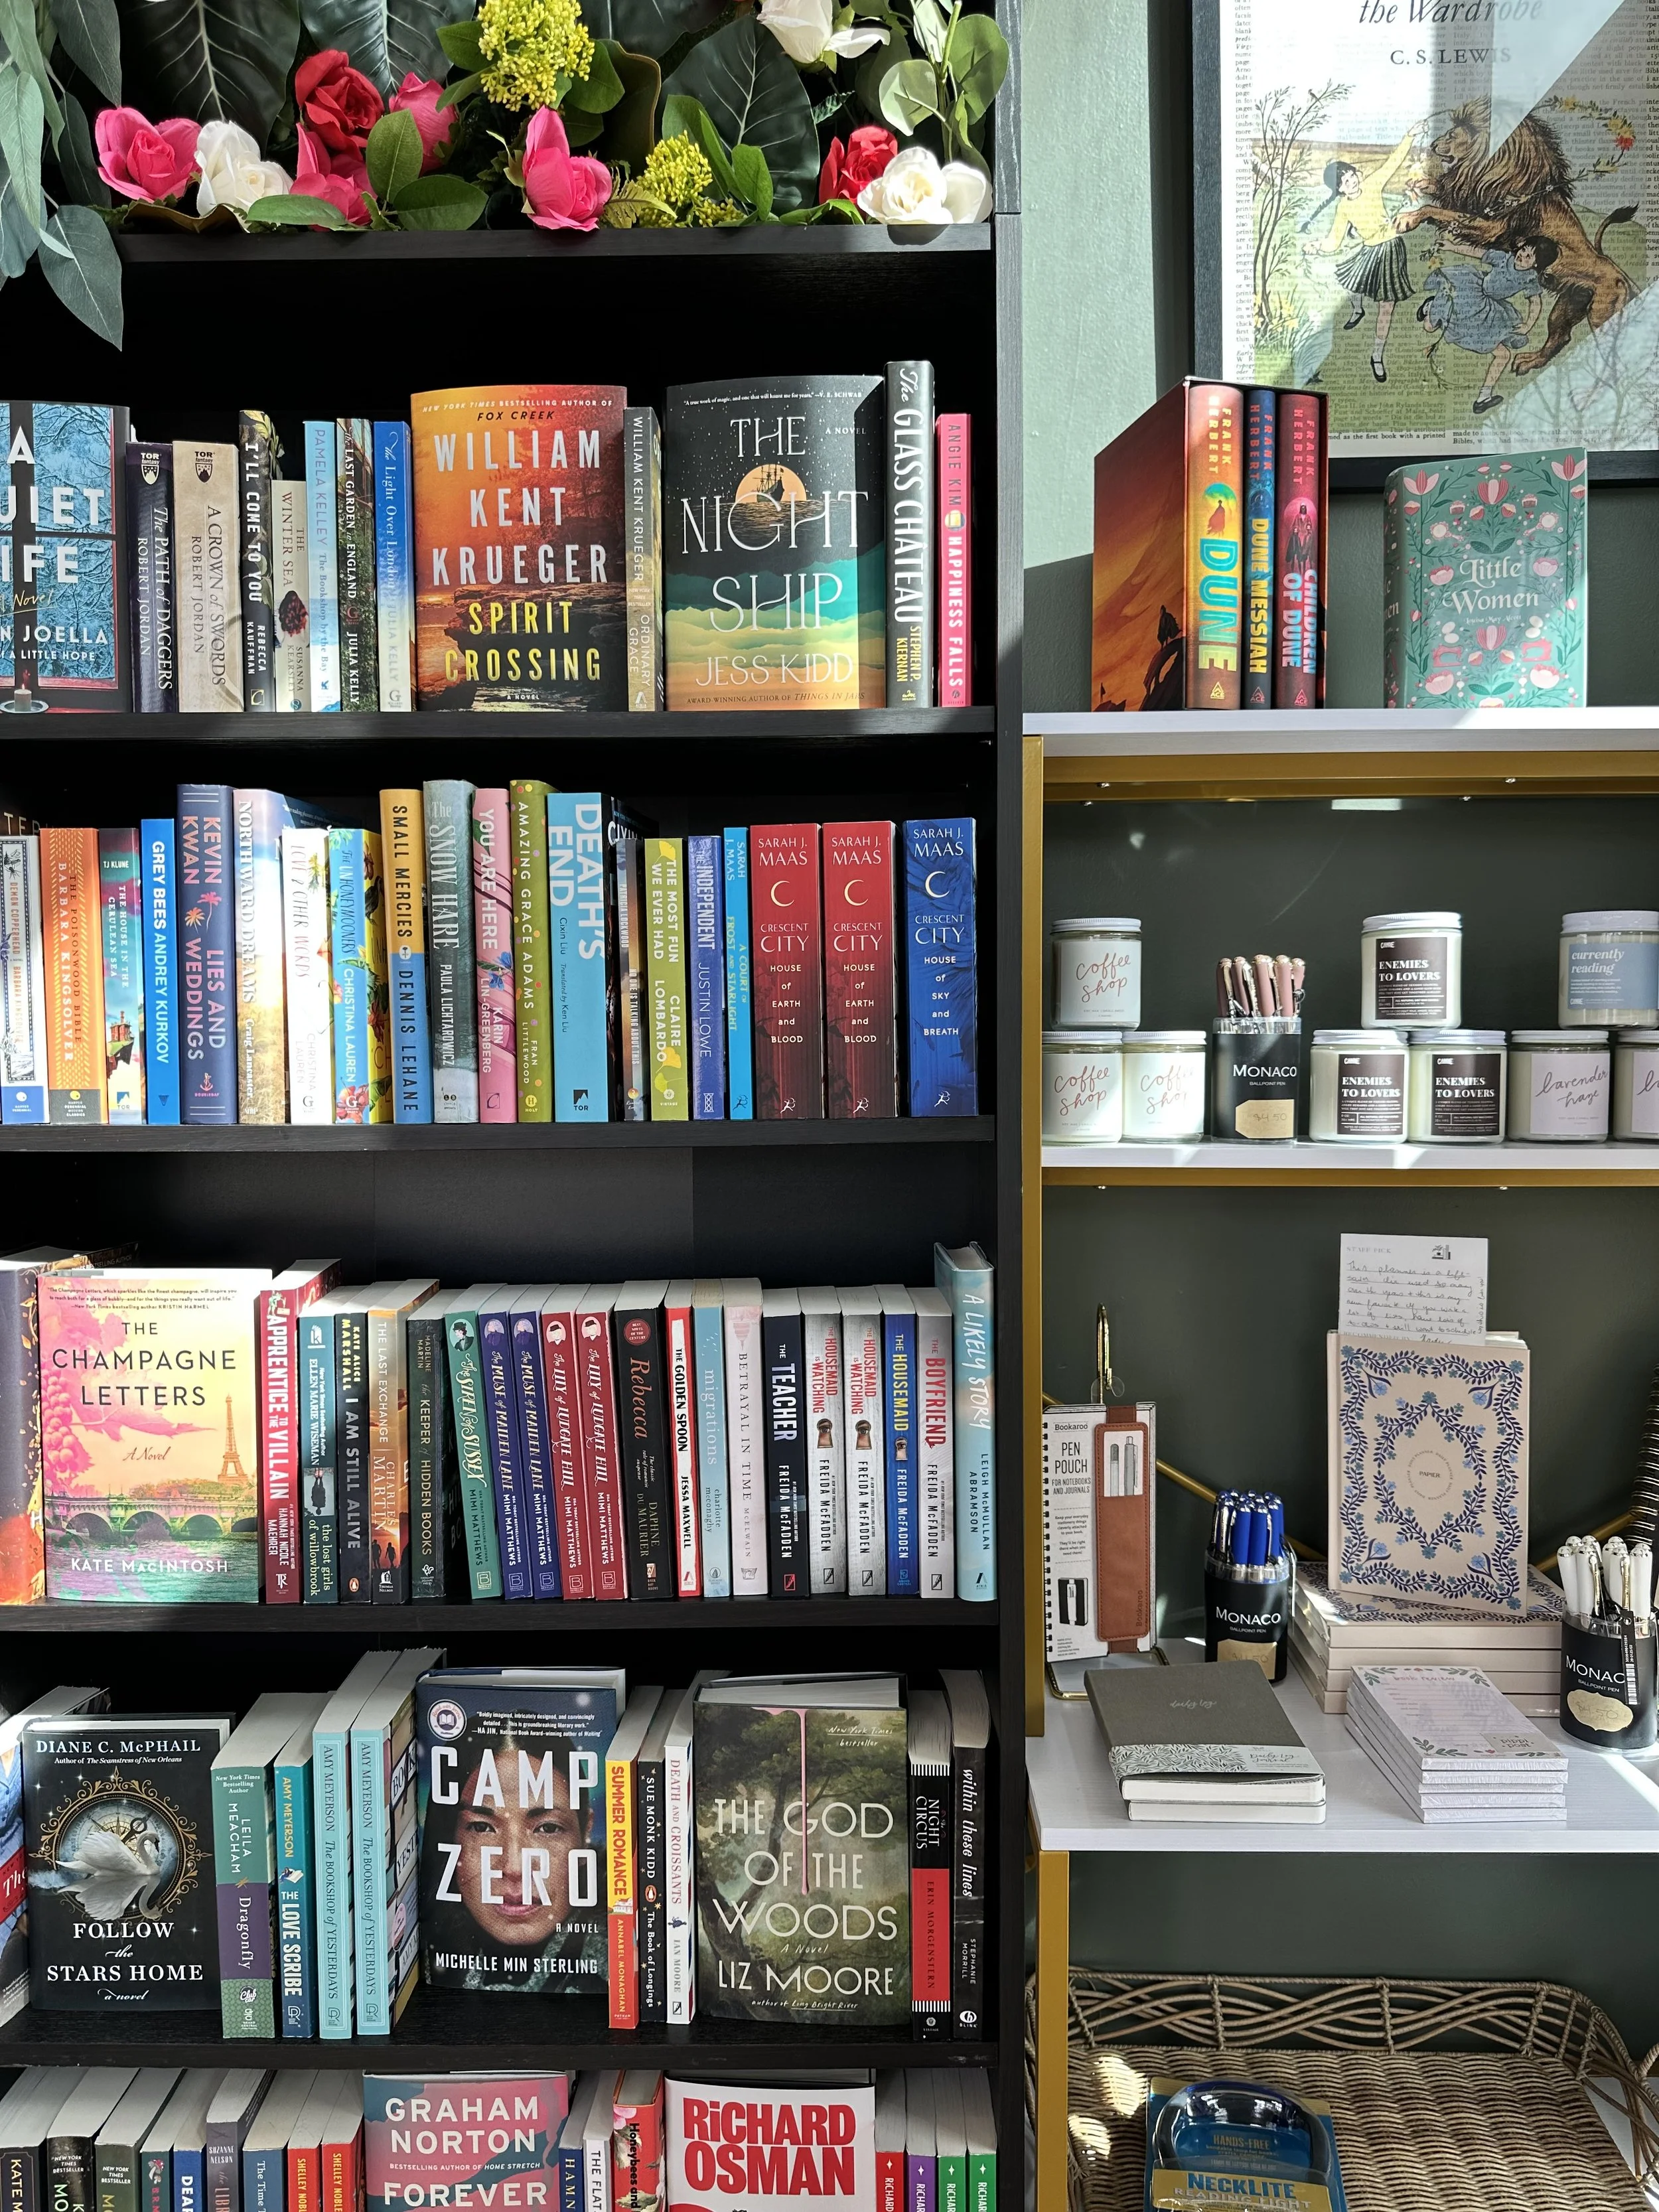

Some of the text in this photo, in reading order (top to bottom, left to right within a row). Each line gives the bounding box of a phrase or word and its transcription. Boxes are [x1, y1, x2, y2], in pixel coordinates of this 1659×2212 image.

[1390, 48, 1511, 65] C. S. LEWIS
[477, 412, 504, 421] FOX
[434, 431, 600, 472] WILLIAM
[731, 416, 806, 458] THE
[246, 491, 261, 533] COME
[470, 488, 565, 528] KENT
[893, 368, 926, 623] The GLASS CHÂTEAU
[681, 490, 868, 554] NIGHT
[248, 543, 261, 562] TO
[432, 544, 607, 586] KRUEGER
[248, 569, 262, 603] YOU
[1460, 559, 1522, 587] Little
[154, 507, 173, 690] The PATH of DAGGERS
[710, 573, 842, 632] SHIP
[948, 536, 962, 687] HAPPINESS FALLS
[1198, 538, 1238, 672] DUNE
[1250, 518, 1269, 674] DUNE MESSIAH
[1442, 592, 1540, 615] Women
[469, 601, 573, 634] SPIRIT
[1282, 573, 1303, 668] OF DUNE
[1303, 569, 1317, 674] CHILDREN
[247, 621, 255, 675] KAUFFMAN
[257, 625, 267, 672] REBECCA
[445, 648, 601, 682] CROSSING
[695, 653, 853, 686] JESS KIDD
[758, 837, 808, 848] SARAH J.
[759, 851, 808, 866] MAAS
[393, 806, 412, 938] SMALL MERCIES
[548, 826, 575, 907] END
[429, 825, 460, 949] SNOW HARE
[760, 922, 809, 932] CRESCENT
[760, 936, 809, 953] CITY
[152, 841, 169, 1064] GREY BEES ANDREY KURKOV
[1379, 960, 1429, 970] ENEMIES
[1571, 949, 1624, 962] currently
[1571, 962, 1615, 975] reading
[781, 982, 791, 991] of
[936, 974, 946, 982] of
[1379, 972, 1440, 981] TO LOVERS
[185, 938, 204, 1060] WEDDINGS
[206, 950, 226, 1048] LIES AND
[932, 992, 949, 1000] SKY
[399, 970, 417, 1111] DENNIS LEHANE
[924, 1027, 959, 1036] BREATH
[1233, 1064, 1297, 1077] MONACO
[122, 1322, 158, 1335] THE
[52, 1349, 236, 1370] CHAMPAGNE
[962, 1294, 991, 1431] A LIKELY STORY
[82, 1386, 206, 1406] LETTERS
[630, 1357, 651, 1439] Rebecca
[676, 1364, 685, 1411] GOLDEN
[771, 1364, 796, 1441] TEACHER
[346, 1412, 358, 1439] AM
[677, 1414, 687, 1452] SPOON
[700, 1369, 718, 1465] migrations
[123, 1446, 171, 1461] A Novel
[1061, 1441, 1080, 1456] PEN
[346, 1449, 359, 1491] STILL
[1055, 1459, 1088, 1475] POUCH
[1063, 1477, 1091, 1486] NOTEBOOKS
[1064, 1486, 1090, 1495] JOURNALS
[322, 1524, 330, 1539] the
[347, 1502, 360, 1550] ALIVE
[71, 1558, 113, 1572] KATE
[309, 1519, 318, 1596] of willowbrook
[322, 1568, 333, 1591] girls
[1215, 1607, 1281, 1625] MONACO
[36, 1739, 200, 1753] DIANE C. McPHAIL
[431, 1746, 599, 1810] CAMP
[611, 1765, 627, 1896] SUMMER ROMANCE
[714, 1799, 893, 1838] THE GOD
[916, 1796, 927, 1849] CIRCUS
[928, 1799, 940, 1846] NIGHT
[962, 1769, 973, 1897] within these lines
[228, 1803, 240, 1873] MEACHAM
[242, 1818, 252, 1857] LEILA
[435, 1843, 598, 1907] ZERO
[745, 1850, 863, 1889] OF THE
[73, 1922, 174, 1938] FOLLOW
[236, 1897, 253, 1970] Dragonfly
[281, 1903, 301, 1939] LOVE
[713, 1898, 897, 1941] WOODS
[105, 1944, 133, 1958] the
[435, 1953, 597, 1974] MICHELLE MIN STERLING
[48, 1965, 203, 1981] STARS HOME
[283, 1944, 303, 1996] SCRIBE
[718, 1960, 893, 1995] LIZ MOORE
[386, 2096, 538, 2123] GRAHAM
[209, 2146, 234, 2154] SUZANNE
[391, 2129, 536, 2154] NORTON
[684, 2140, 855, 2195] OSMAN
[384, 2181, 547, 2207] FOREVER
[1187, 2172, 1295, 2199] NECKLITE
[1254, 2193, 1313, 2210] LIGHT
